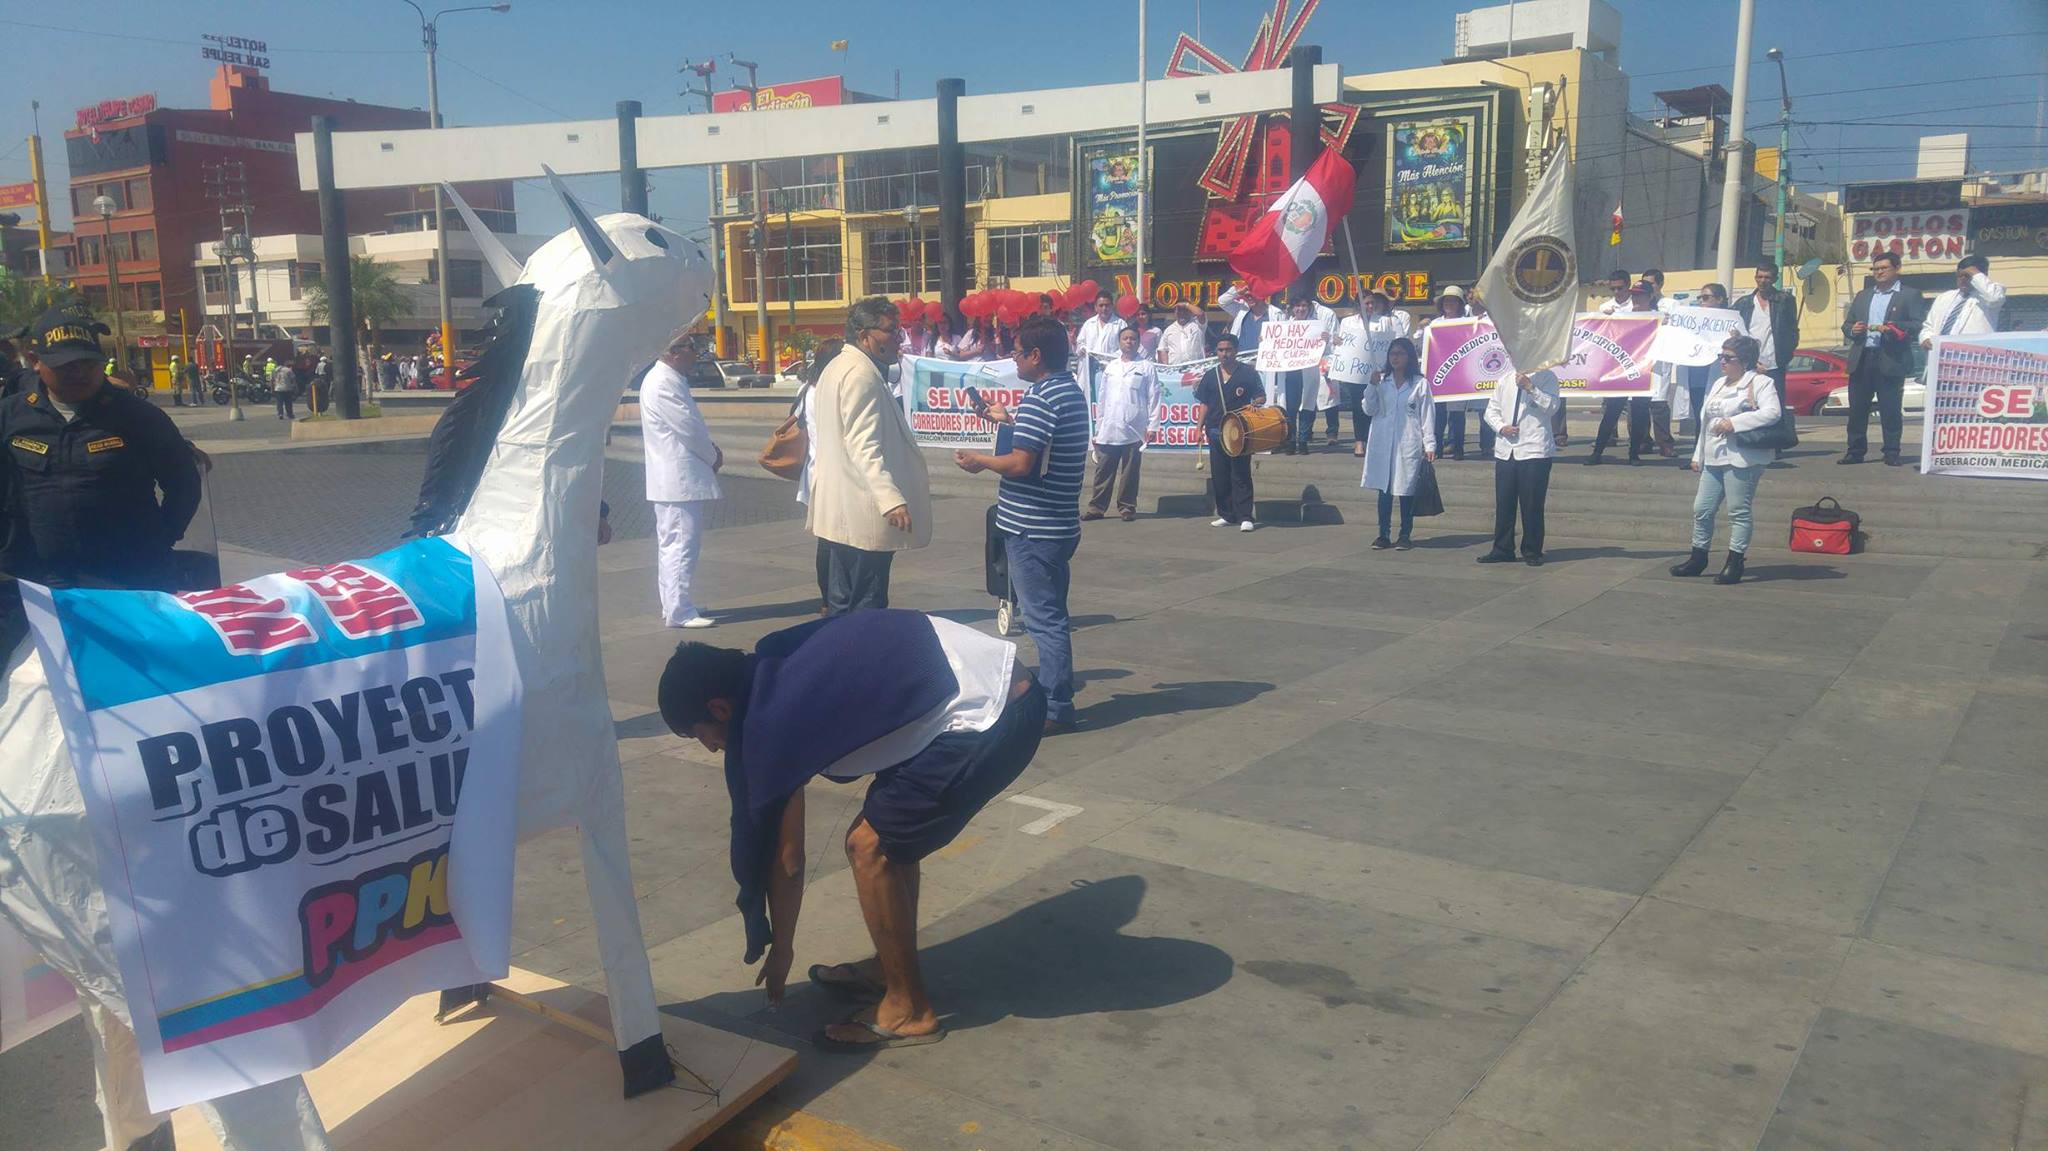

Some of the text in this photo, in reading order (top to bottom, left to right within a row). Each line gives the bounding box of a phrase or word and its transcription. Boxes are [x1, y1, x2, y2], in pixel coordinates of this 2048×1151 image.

[741, 95, 810, 112] discón
[758, 91, 771, 105] El
[1397, 169, 1420, 182] Más
[1855, 214, 1965, 238] POLLOS
[1852, 237, 1965, 262] GASTON
[1318, 271, 1429, 304] OUGE
[45, 326, 95, 347] POLICIA
[1265, 324, 1310, 339] NO HAY
[1273, 338, 1324, 350] MEDICINAS
[1434, 354, 1459, 385] CUERPO
[1458, 335, 1490, 357] MEDICO
[1581, 330, 1620, 356] PACIFICO
[1617, 350, 1640, 379] NORE
[927, 388, 1025, 409] SE VNDE
[1981, 388, 2033, 414] SE
[912, 413, 962, 431] CORREDORES
[964, 414, 983, 432] PPK
[1170, 404, 1189, 421] SE
[1167, 427, 1185, 444] SE
[1937, 426, 2048, 452] CORREDORES
[1934, 457, 2048, 469] FEDERACIÓN MEDICA
[136, 667, 475, 811] PROYECT
[191, 746, 470, 875] de SALU
[300, 848, 450, 974] PPK
